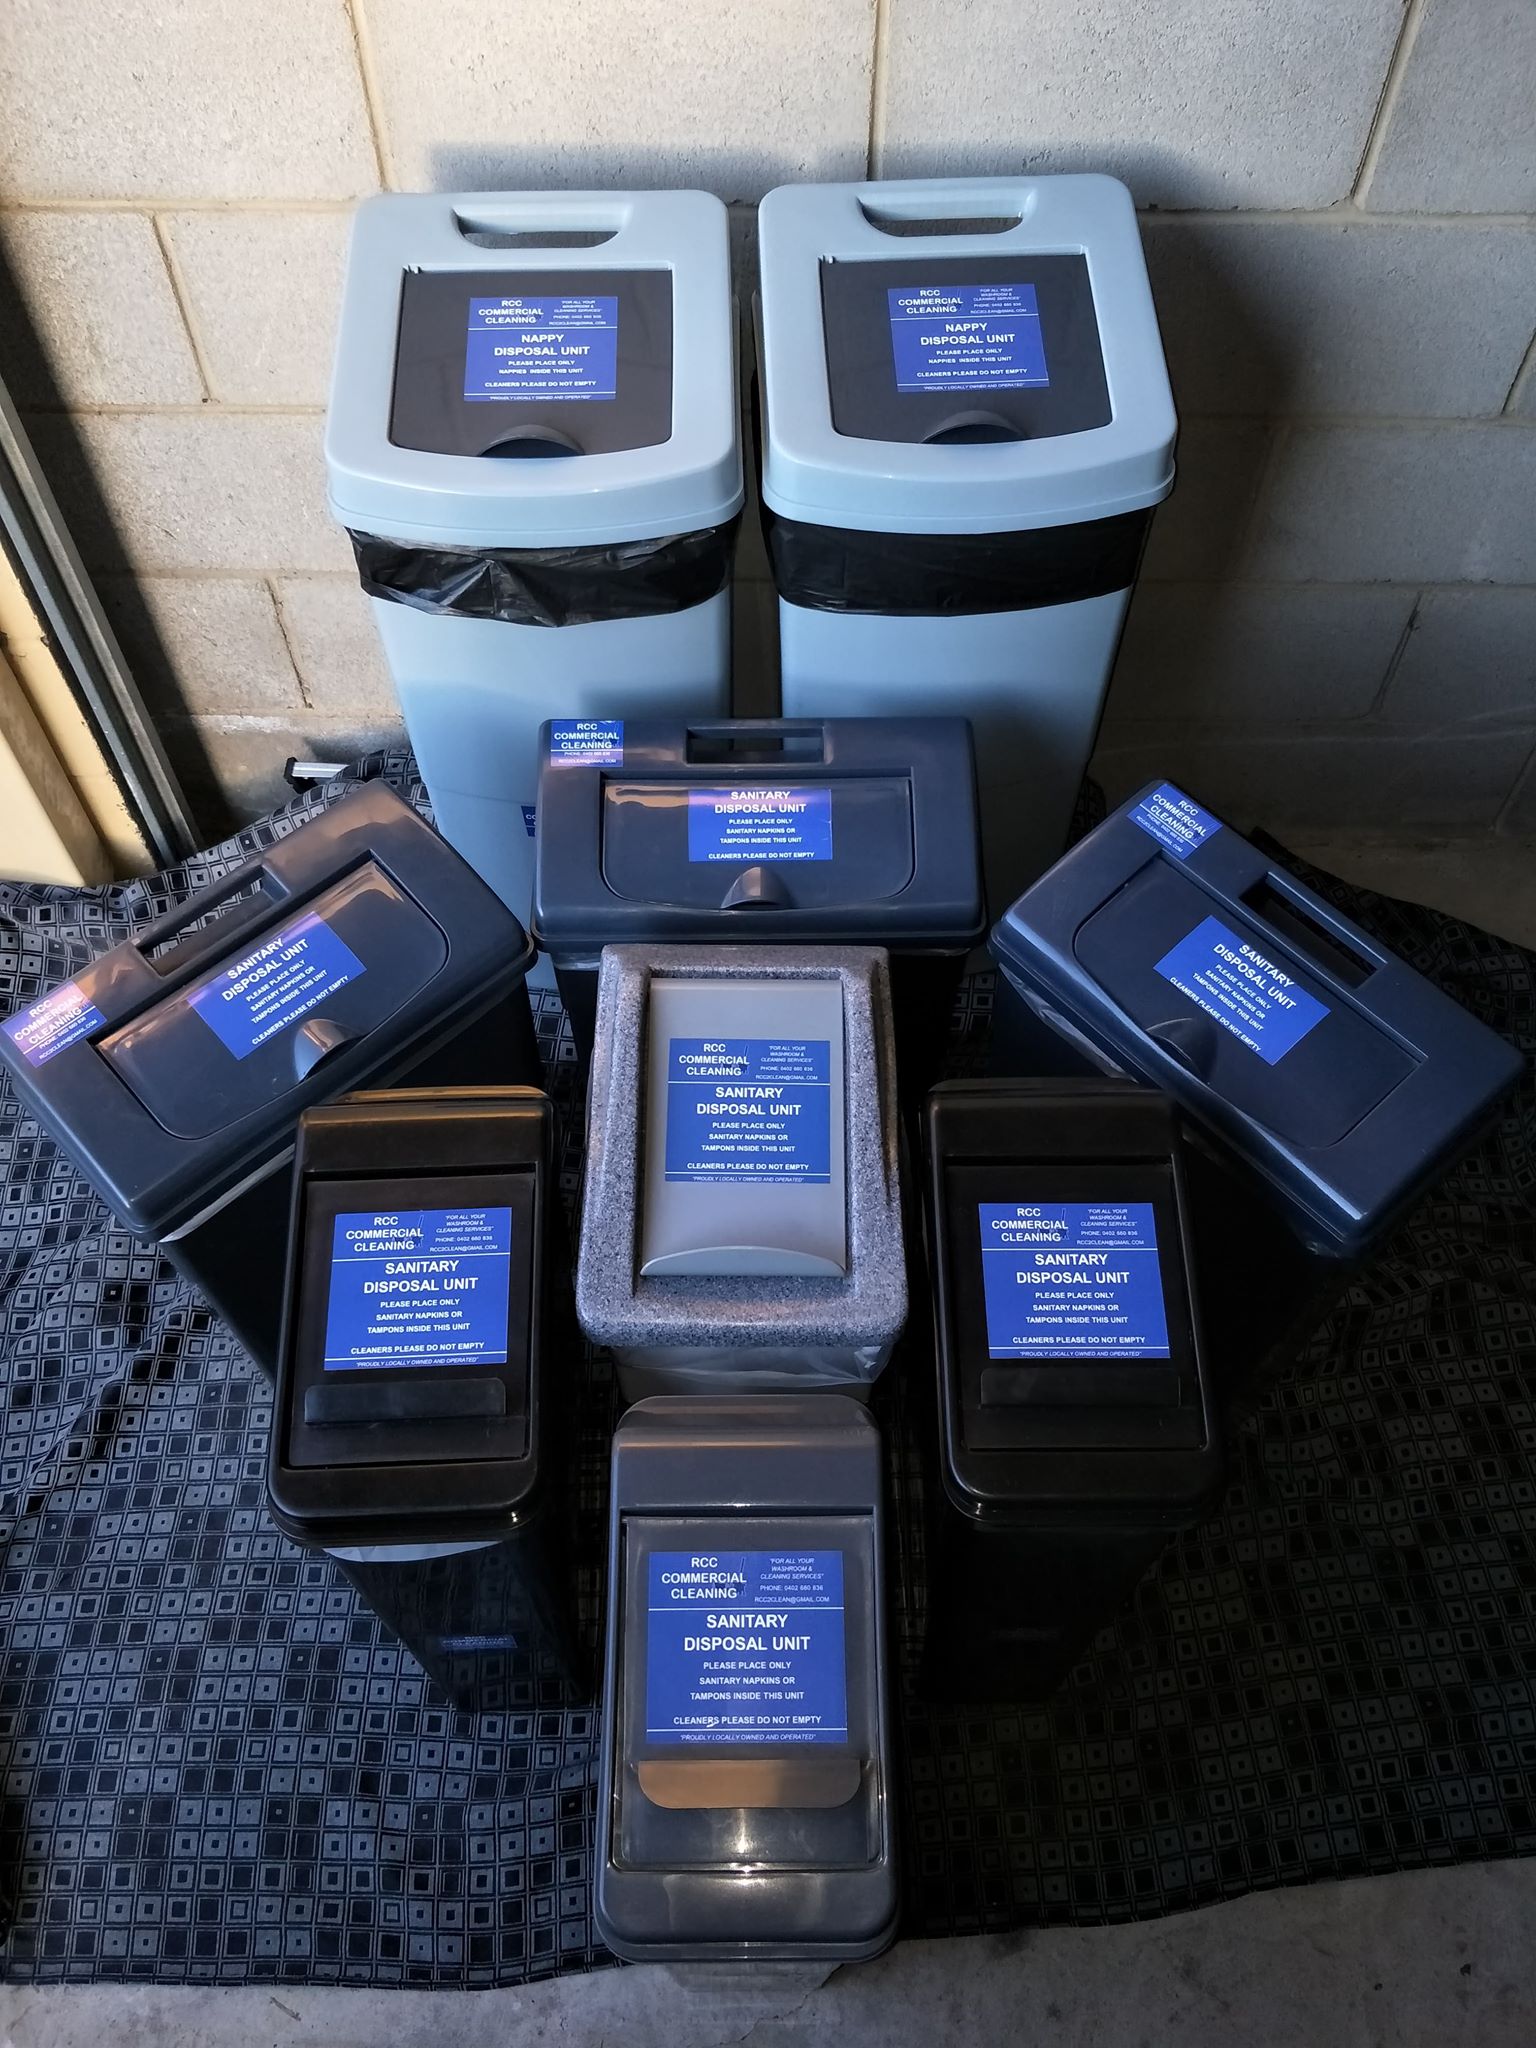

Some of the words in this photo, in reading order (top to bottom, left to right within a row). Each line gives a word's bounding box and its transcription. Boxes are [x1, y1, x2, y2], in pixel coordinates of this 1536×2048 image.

[919, 289, 941, 297] RCC
[501, 299, 522, 307] RCC
[898, 297, 964, 306] COMMERCIAL
[478, 308, 544, 316] COMMERCIAL
[906, 305, 957, 314] CLEANING
[485, 316, 537, 324] CLEANING
[945, 322, 988, 333] NAPPY
[521, 334, 564, 343] NAPPY
[920, 335, 984, 346] DISPOSAL
[986, 333, 1015, 343] UNIT
[494, 346, 558, 356] DISPOSAL
[561, 346, 591, 355] UNIT
[576, 723, 598, 731] RCC
[554, 732, 620, 740] COMMERCIAL
[561, 741, 612, 749] CLEANING
[731, 790, 791, 801] SANITARY
[715, 804, 776, 814] DISPOSAL
[778, 804, 806, 813] UNIT
[1178, 800, 1199, 816] RCC
[1152, 794, 1207, 837] COMMERCIAL
[1150, 805, 1194, 839] CLEANING
[227, 938, 284, 980] SANITARY
[221, 958, 283, 1001] DISPOSAL
[279, 938, 309, 962] UNIT
[1239, 944, 1295, 988] SANITARY
[1213, 943, 1267, 990] DISPOSAL
[1267, 986, 1297, 1009] UNIT
[29, 1000, 52, 1018] RCC
[14, 995, 84, 1041] COMMERCIAL
[29, 1006, 83, 1045] CLEANING
[703, 1043, 726, 1052] RCC
[678, 1055, 750, 1065] COMMERCIAL
[686, 1066, 742, 1076] CLEANING
[715, 1086, 784, 1098] SANITARY
[696, 1103, 766, 1115] DISPOSAL
[770, 1104, 802, 1116] UNIT
[701, 1144, 736, 1152] TAMPONS
[1017, 1207, 1041, 1217] RCC
[374, 1216, 399, 1226] RCC
[991, 1220, 1069, 1230] COMMERCIAL
[345, 1228, 424, 1240] COMMERCIAL
[1001, 1232, 1062, 1242] CLEANING
[354, 1240, 416, 1252] CLEANING
[1035, 1253, 1108, 1266] SANITARY
[385, 1260, 460, 1275] SANITARY
[1016, 1272, 1092, 1284] DISPOSAL
[1095, 1272, 1130, 1284] UNIT
[363, 1279, 440, 1294] DISPOSAL
[443, 1277, 479, 1291] UNIT
[380, 1300, 411, 1308] PLEASE
[412, 1299, 438, 1307] PLACE
[439, 1298, 460, 1306] ONLY
[376, 1312, 414, 1321] SANITARY
[415, 1311, 450, 1319] NAPKINS
[450, 1310, 463, 1318] OR
[1025, 1316, 1063, 1324] TAMPONS
[1064, 1316, 1090, 1324] INSIDE
[1091, 1316, 1109, 1324] THIS
[1110, 1316, 1128, 1324] UNIT
[367, 1325, 405, 1334] TAMPONS
[405, 1324, 432, 1333] INSIDE
[433, 1323, 451, 1331] THIS
[452, 1322, 471, 1331] UNIT
[1012, 1336, 1055, 1344] CLEANERS
[1055, 1336, 1087, 1344] PLEASE
[1087, 1336, 1100, 1344] DO
[1101, 1336, 1118, 1344] NOT
[1119, 1336, 1146, 1344] EMPTY
[350, 1346, 393, 1355] CLEANERS
[394, 1344, 425, 1353] PLEASE
[426, 1344, 439, 1352] DO
[439, 1343, 457, 1351] NOT
[457, 1342, 485, 1350] EMPTY
[691, 1557, 718, 1568] RCC
[661, 1572, 747, 1584] COMMERCIAL
[671, 1587, 738, 1599] CLEANING
[706, 1614, 788, 1628] SANITARY
[684, 1636, 768, 1651] DISPOSAL
[772, 1636, 811, 1651] UNIT
[703, 1661, 737, 1670] PLEASE
[738, 1661, 767, 1670] PLACE
[768, 1661, 792, 1669] ONLY
[699, 1677, 741, 1685] SANITARY
[742, 1676, 781, 1685] NAPKINS
[782, 1676, 796, 1685] OR
[690, 1692, 732, 1700] TAMPONS
[733, 1691, 761, 1700] INSIDE
[763, 1691, 783, 1700] THIS
[784, 1691, 804, 1700] UNIT
[673, 1716, 720, 1725] CLEANERS
[721, 1716, 755, 1724] PLEASE
[757, 1716, 771, 1724] DO
[772, 1716, 791, 1724] NOT
[792, 1715, 822, 1724] EMPTY
